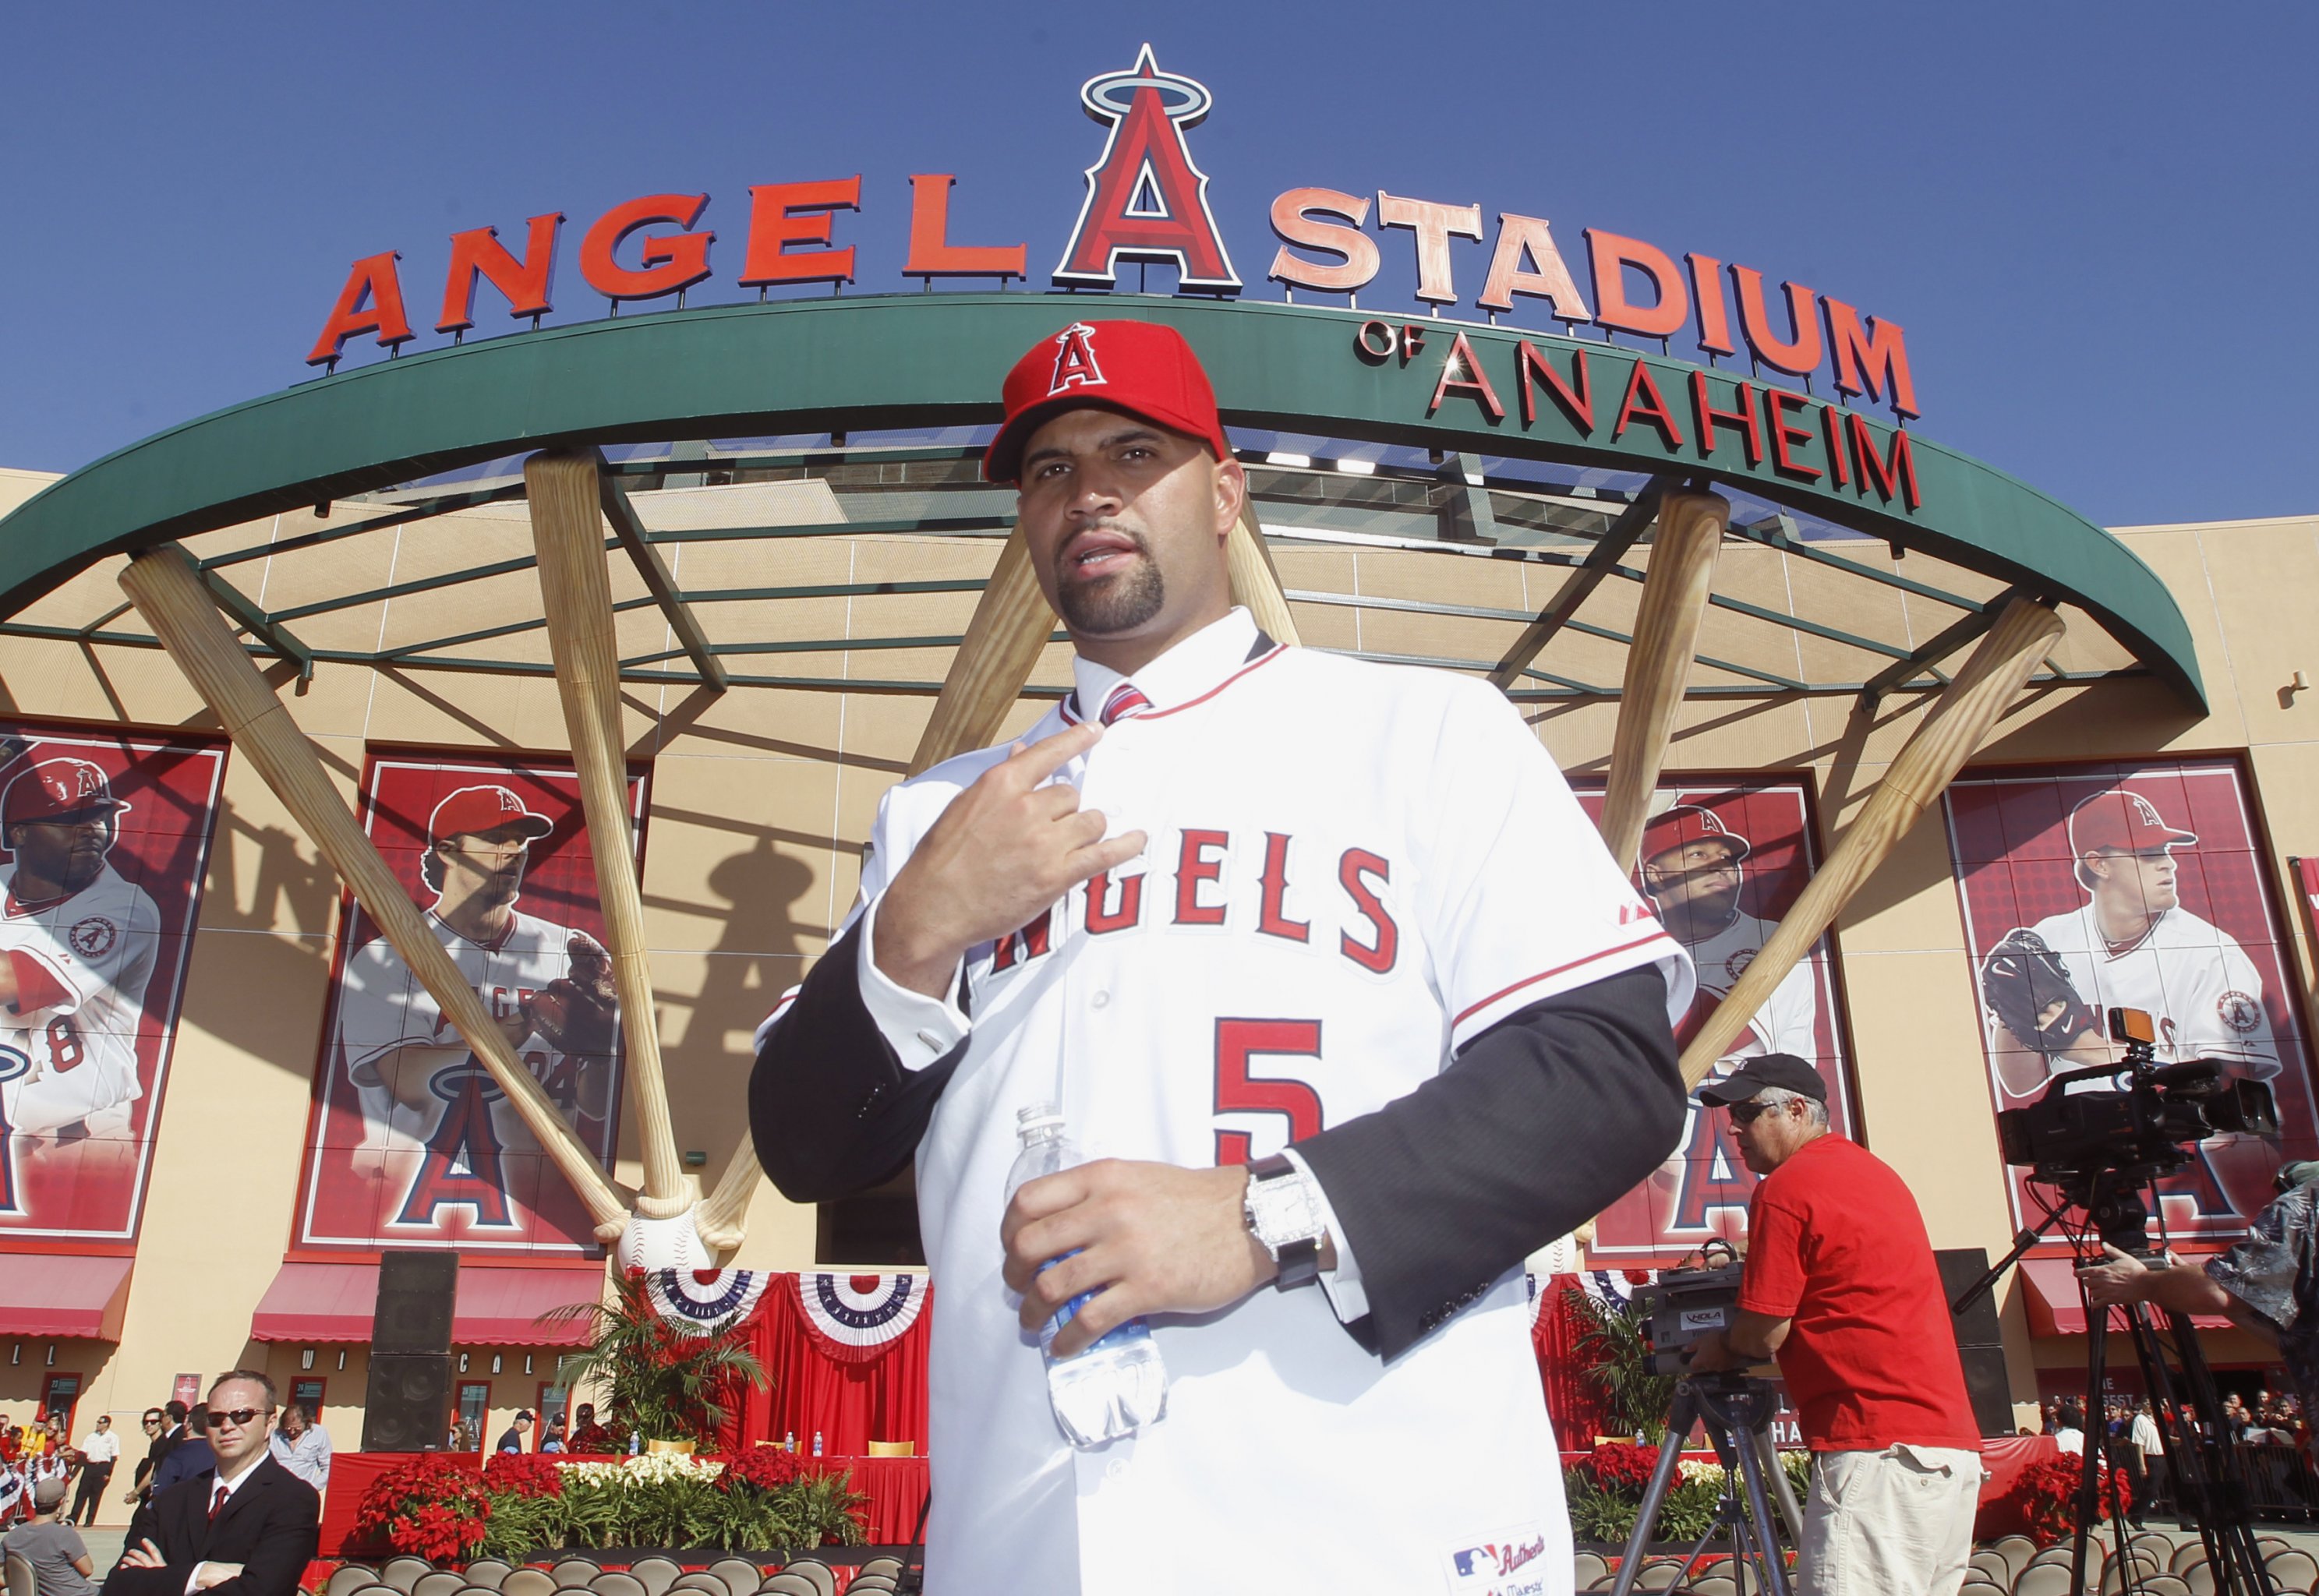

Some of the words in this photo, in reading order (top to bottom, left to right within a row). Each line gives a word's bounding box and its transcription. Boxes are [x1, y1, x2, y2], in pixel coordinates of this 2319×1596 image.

[305, 173, 1027, 366] ANGEL
[1267, 187, 1921, 418] STADIUM
[1358, 320, 1426, 362] OF
[1428, 330, 1921, 513] ANAHEIM
[990, 828, 1400, 976] GELS
[1213, 1017, 1324, 1167] 5
[1692, 1312, 1721, 1320] HOLA
